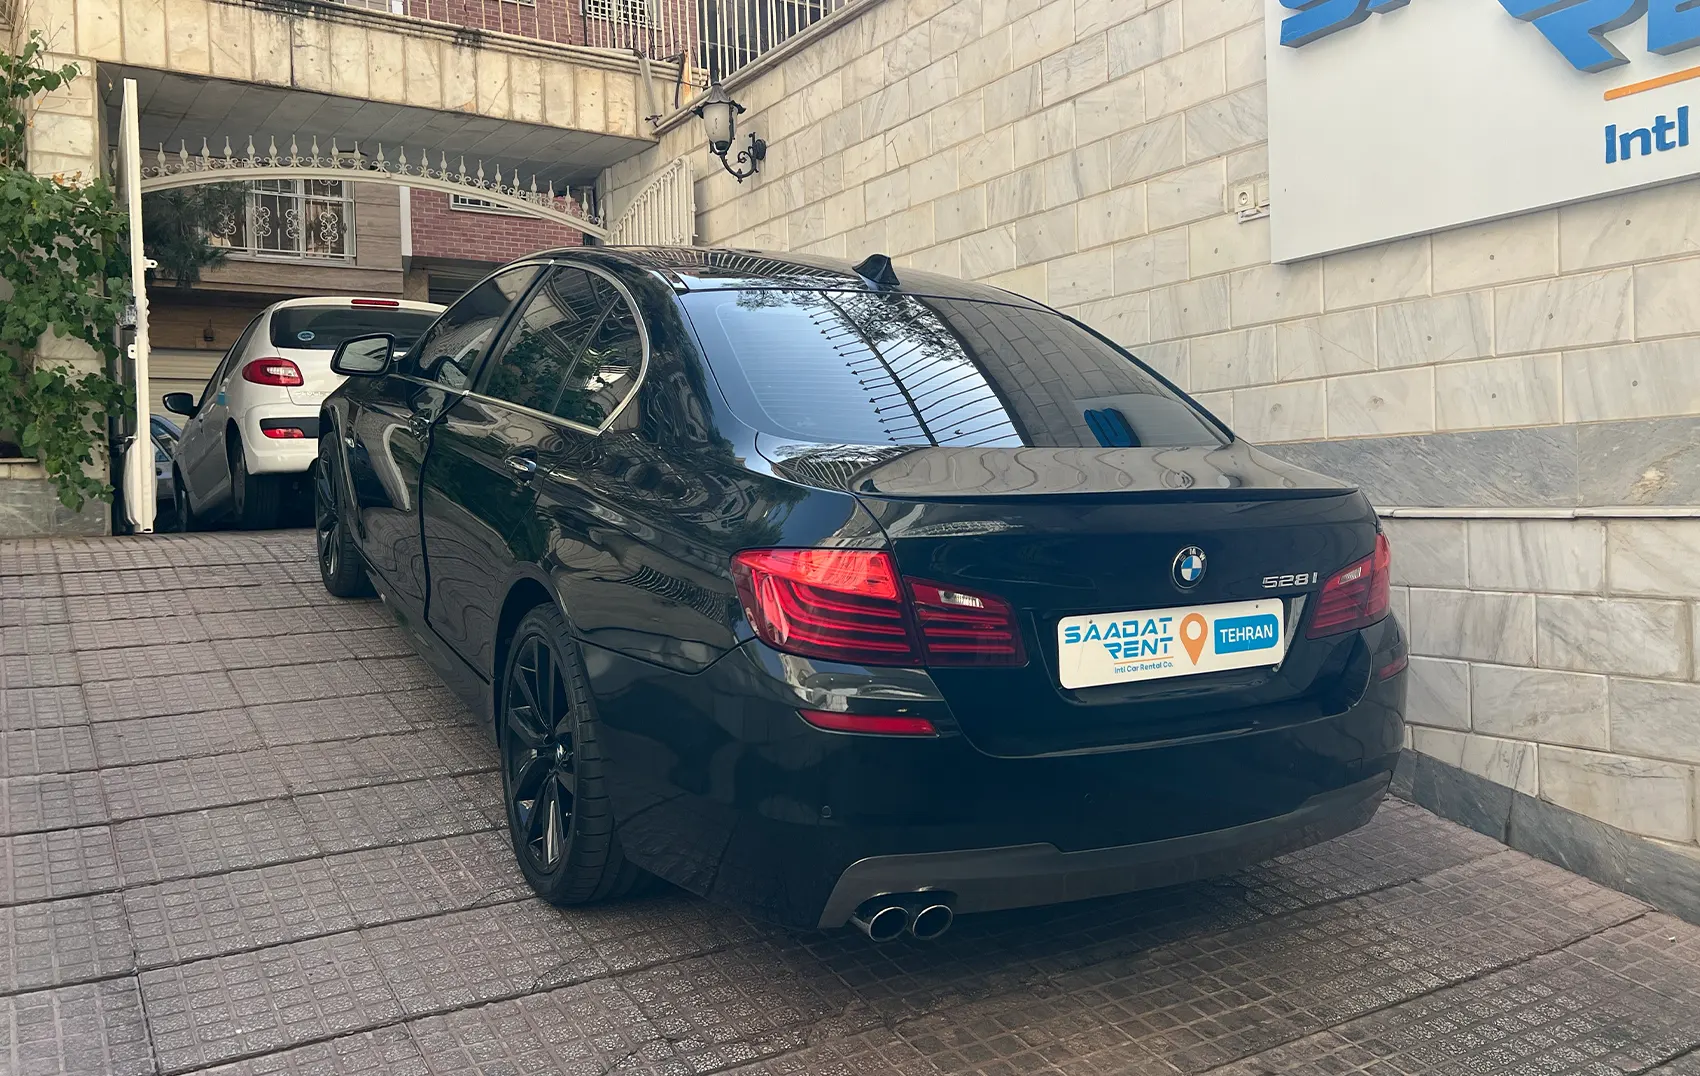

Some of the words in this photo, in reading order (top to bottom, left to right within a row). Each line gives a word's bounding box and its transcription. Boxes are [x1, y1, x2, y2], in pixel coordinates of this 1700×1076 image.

[1604, 105, 1690, 164] Intl
[1178, 548, 1206, 562] BMW
[1064, 616, 1173, 644] SAADAT
[1219, 623, 1273, 644] TEHRAN
[1103, 636, 1174, 660] RENT
[1114, 666, 1126, 674] Intl
[1126, 664, 1139, 673] Car
[1140, 661, 1162, 671] Rental
[1162, 660, 1174, 668] Co.
